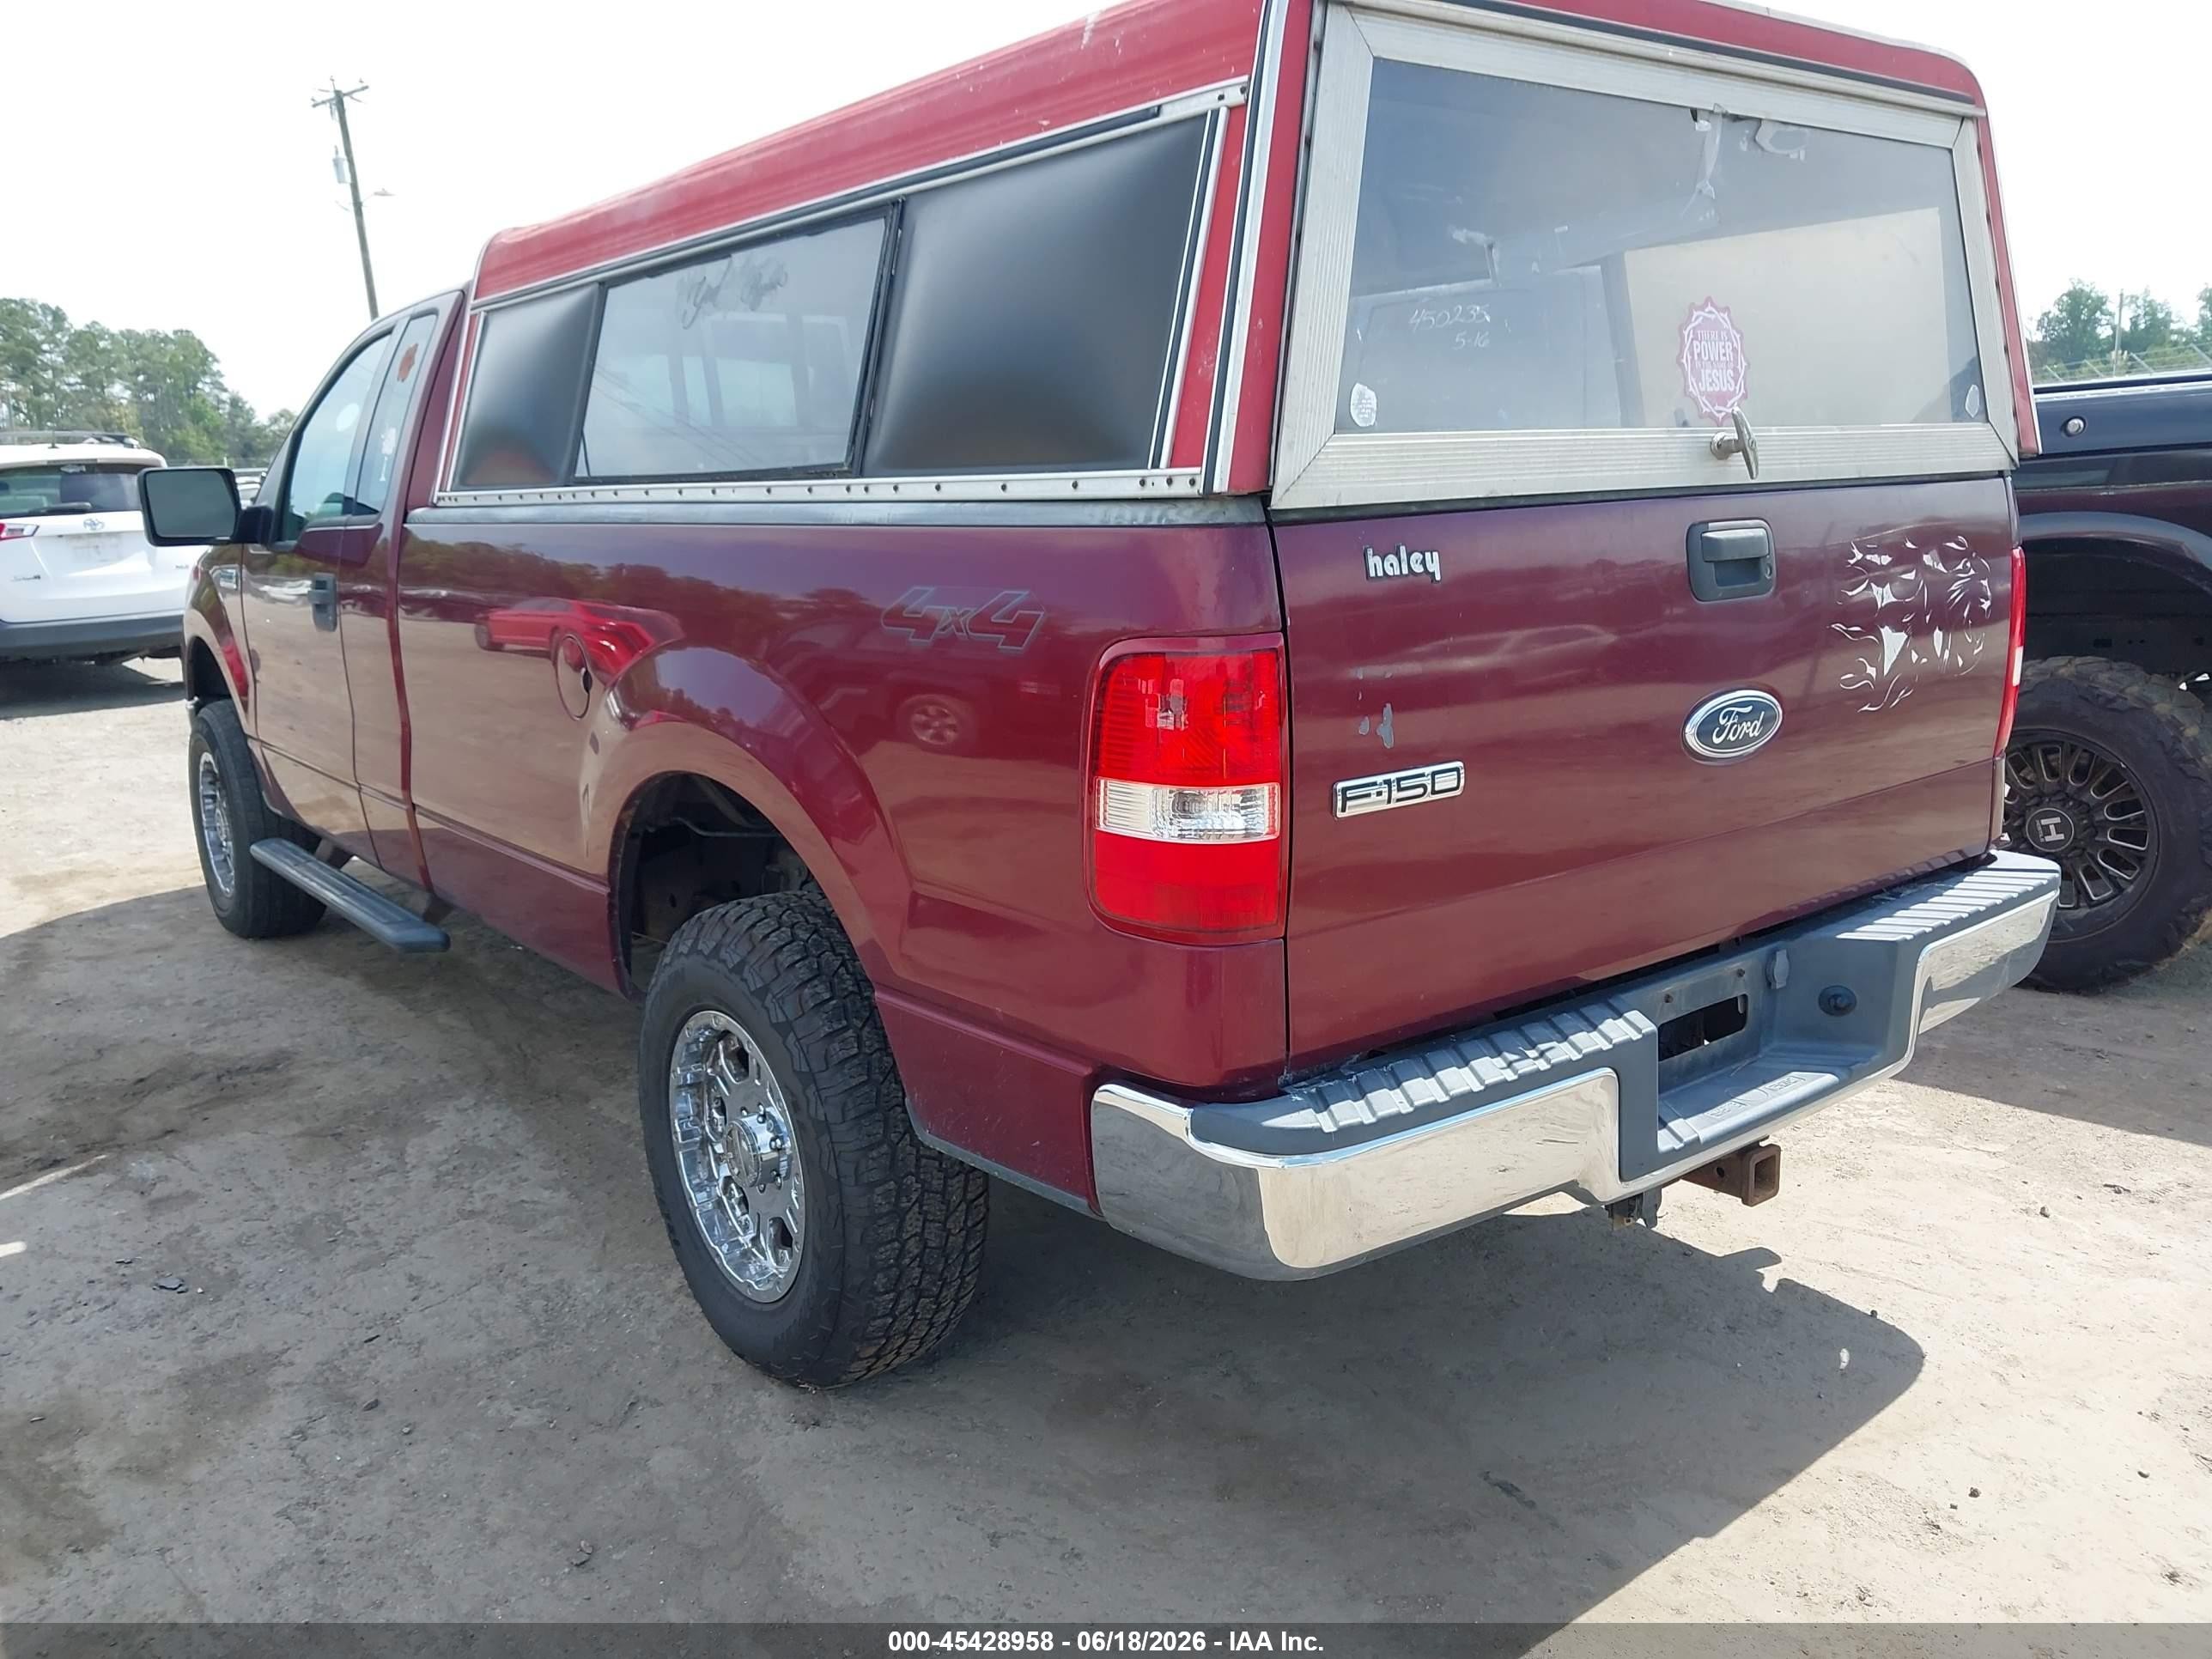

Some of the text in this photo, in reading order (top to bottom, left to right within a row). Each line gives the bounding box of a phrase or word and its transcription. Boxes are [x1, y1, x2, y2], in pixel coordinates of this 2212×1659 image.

[1692, 340, 1734, 362] POWER
[1698, 369, 1735, 392] JESUS
[1364, 544, 1442, 584] haley
[881, 586, 1045, 652] 4x4
[1712, 705, 1765, 744] Ford
[1340, 766, 1462, 813] F-150
